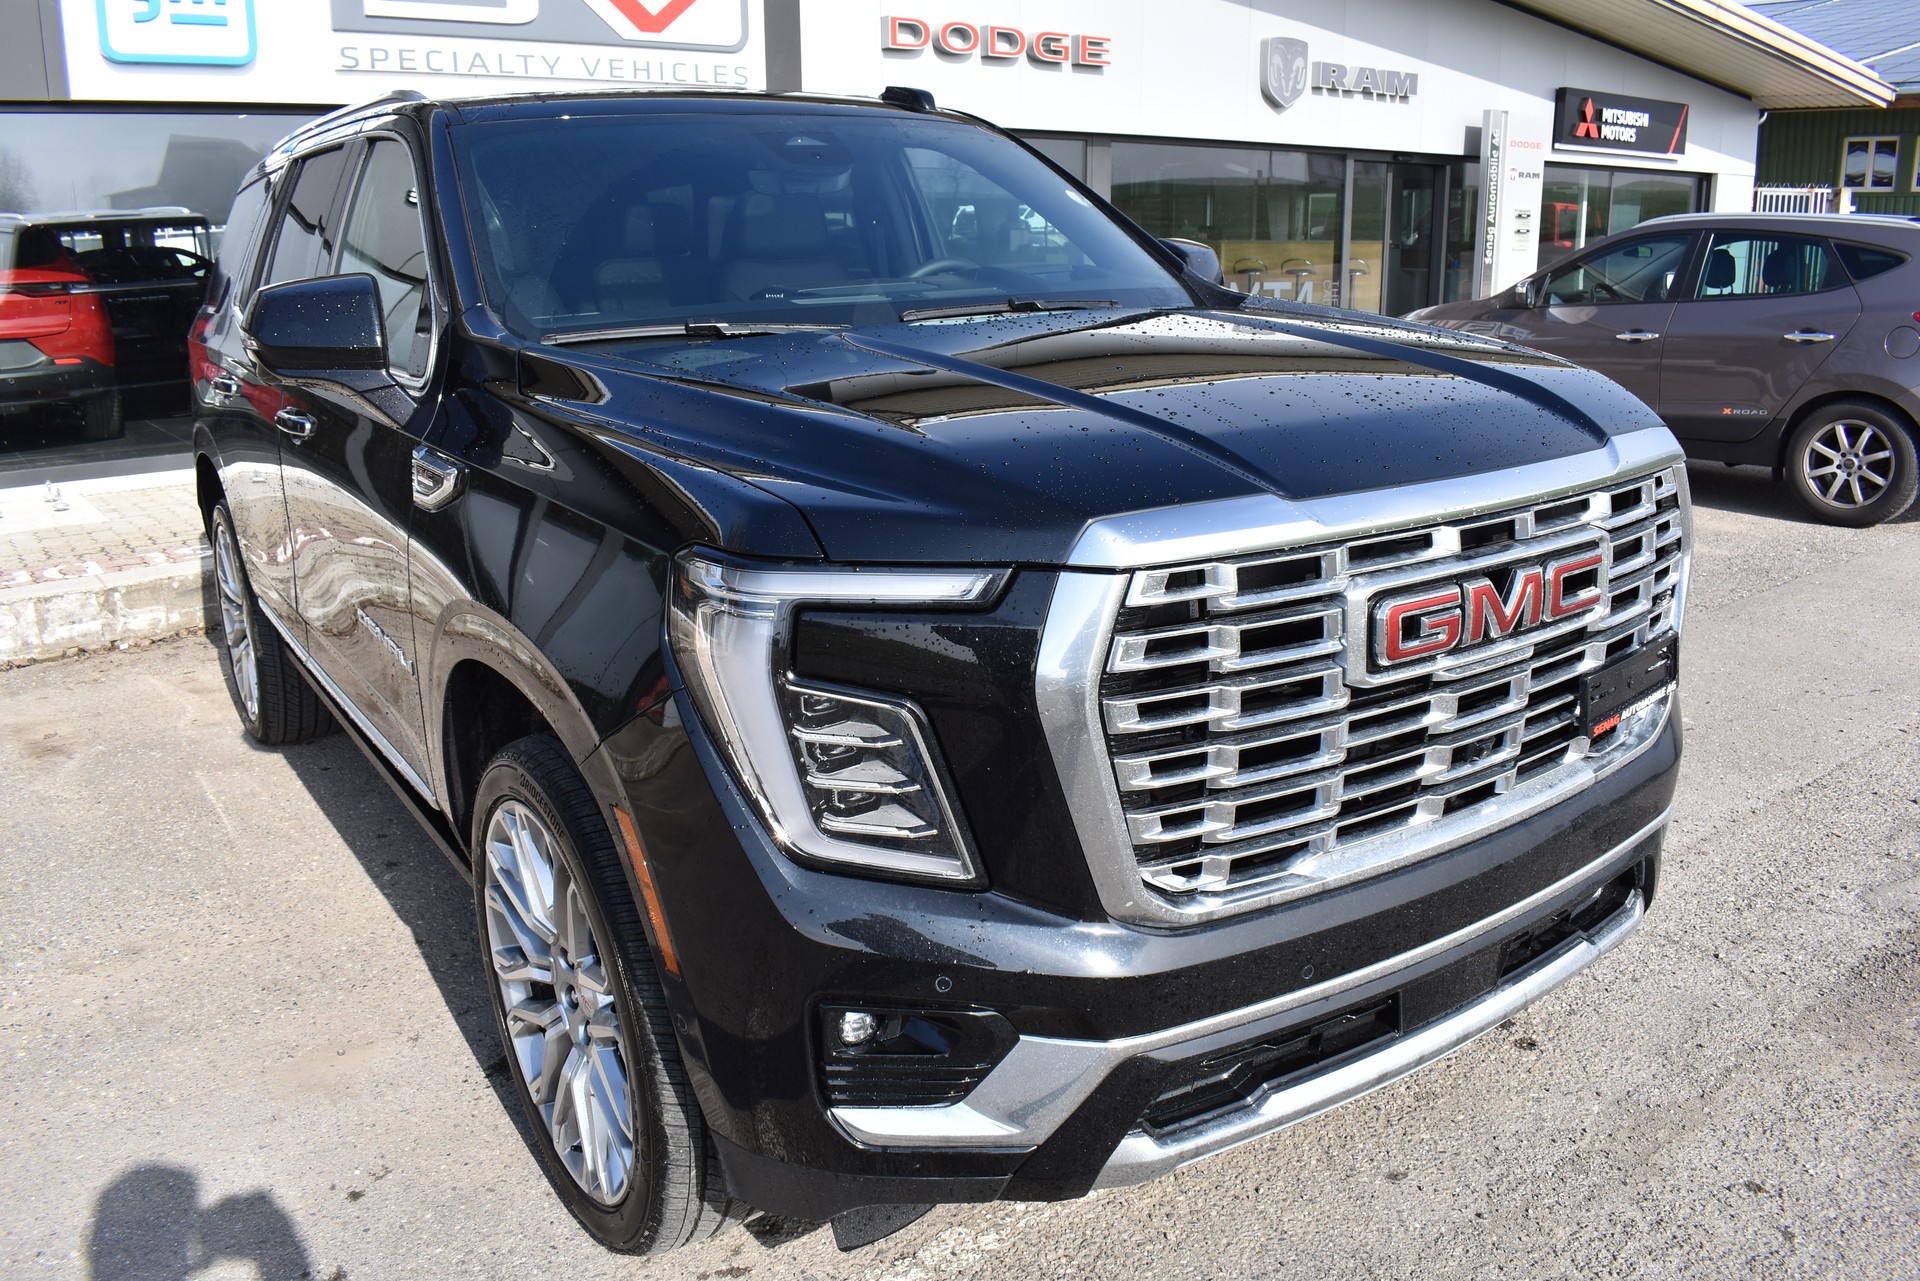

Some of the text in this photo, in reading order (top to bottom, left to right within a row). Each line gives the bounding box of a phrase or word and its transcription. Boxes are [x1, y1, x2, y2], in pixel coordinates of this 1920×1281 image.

[881, 15, 1111, 66] DODGE
[340, 46, 749, 86] SPECIALTY VEHICLES
[1313, 61, 1419, 97] RAM
[1600, 124, 1636, 142] MOTORS
[1602, 107, 1649, 127] MITSUBISHI
[1510, 140, 1542, 150] DODGE
[1518, 171, 1540, 179] RAM
[1484, 129, 1500, 265] Senag Automobile AG
[1377, 552, 1604, 666] GMC
[1593, 680, 1677, 737] SENAG AUTOMOBILE AG
[519, 772, 567, 843] BRIDGESTONE
